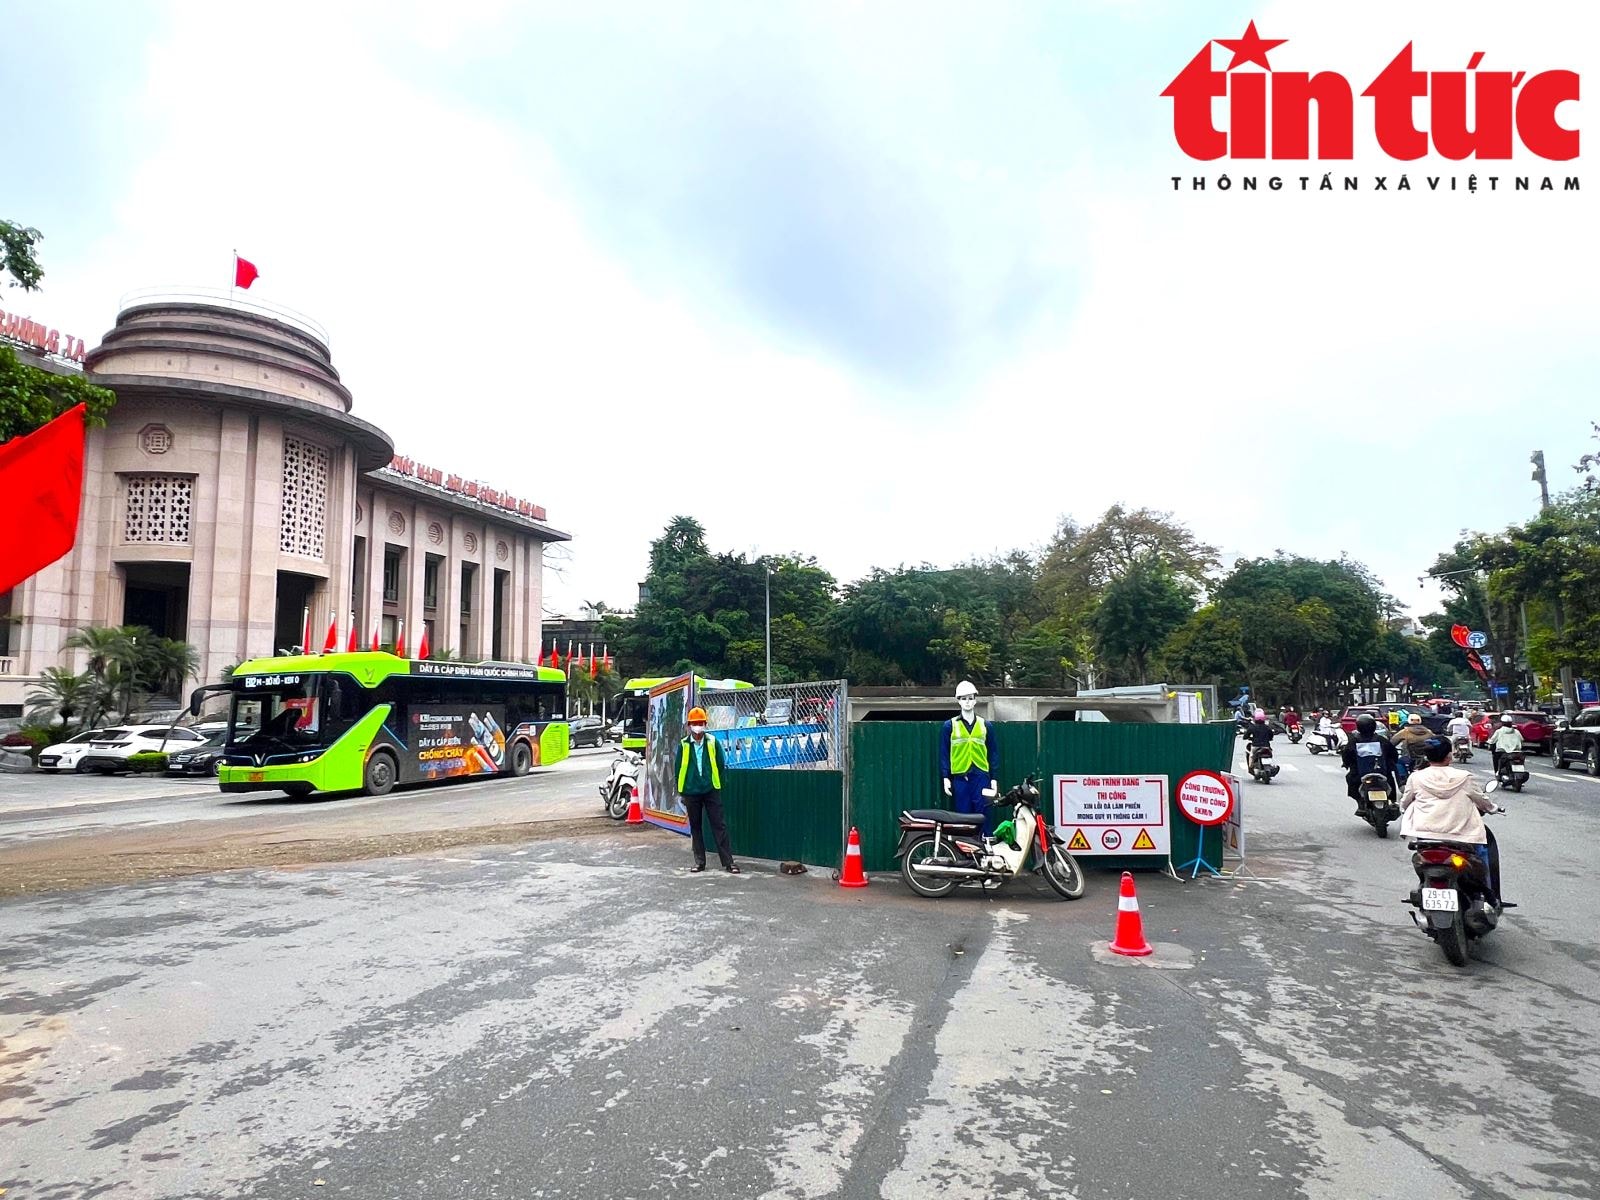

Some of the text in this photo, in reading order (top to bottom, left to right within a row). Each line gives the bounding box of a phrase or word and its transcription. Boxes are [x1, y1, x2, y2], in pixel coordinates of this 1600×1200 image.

[1083, 776, 1101, 787] CÔNG
[1102, 776, 1121, 787] TRÌNH
[1184, 781, 1201, 792] CÔNG
[1097, 790, 1127, 801] THI CÔNG
[1199, 796, 1209, 804] THI
[1209, 798, 1226, 808] CÔNG
